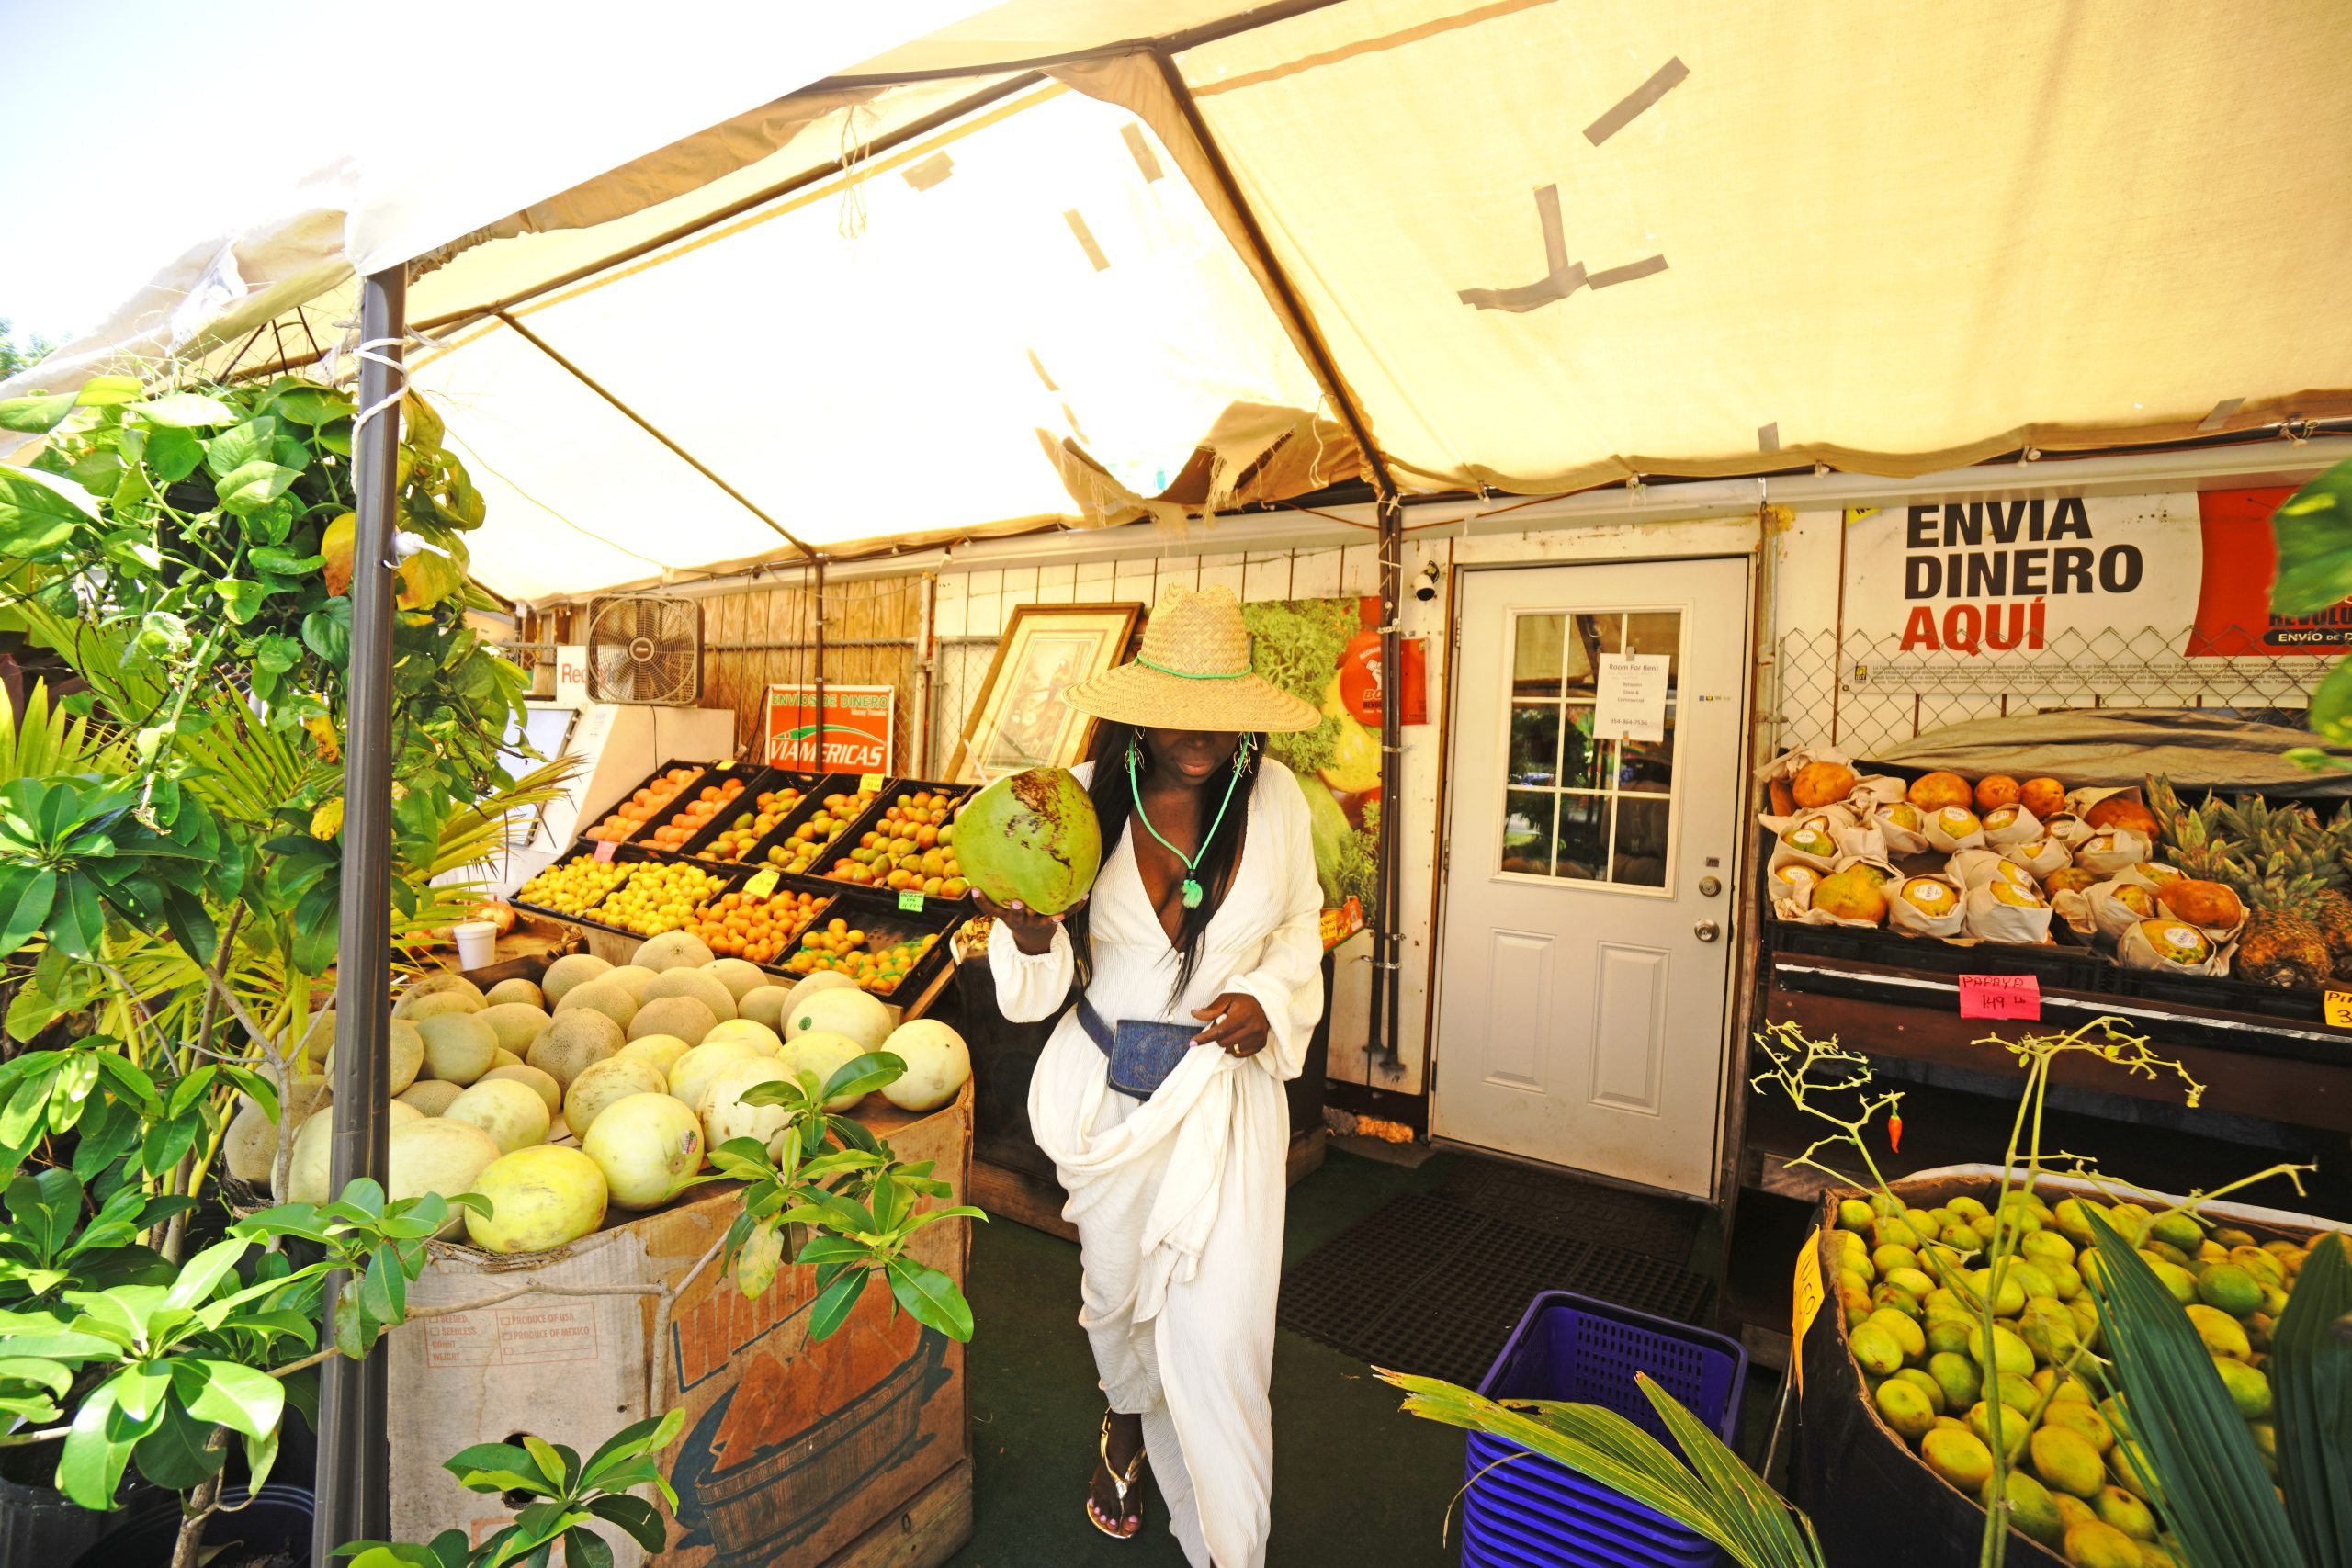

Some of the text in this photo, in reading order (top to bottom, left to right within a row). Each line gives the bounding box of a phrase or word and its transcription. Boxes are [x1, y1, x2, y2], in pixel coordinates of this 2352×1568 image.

[1907, 497, 2093, 548] ENVIA
[1905, 544, 2143, 599] DINERO
[1899, 597, 2046, 657] AQUÍ
[841, 694, 888, 708] DINERO
[1962, 976, 2024, 990] PAPAYA
[440, 1314, 468, 1324] SEEDED
[512, 1313, 574, 1325] PRODUCE OF USA
[514, 1325, 590, 1340] PRODUCE OF MEXICO
[433, 1353, 461, 1362] WEIGHT
